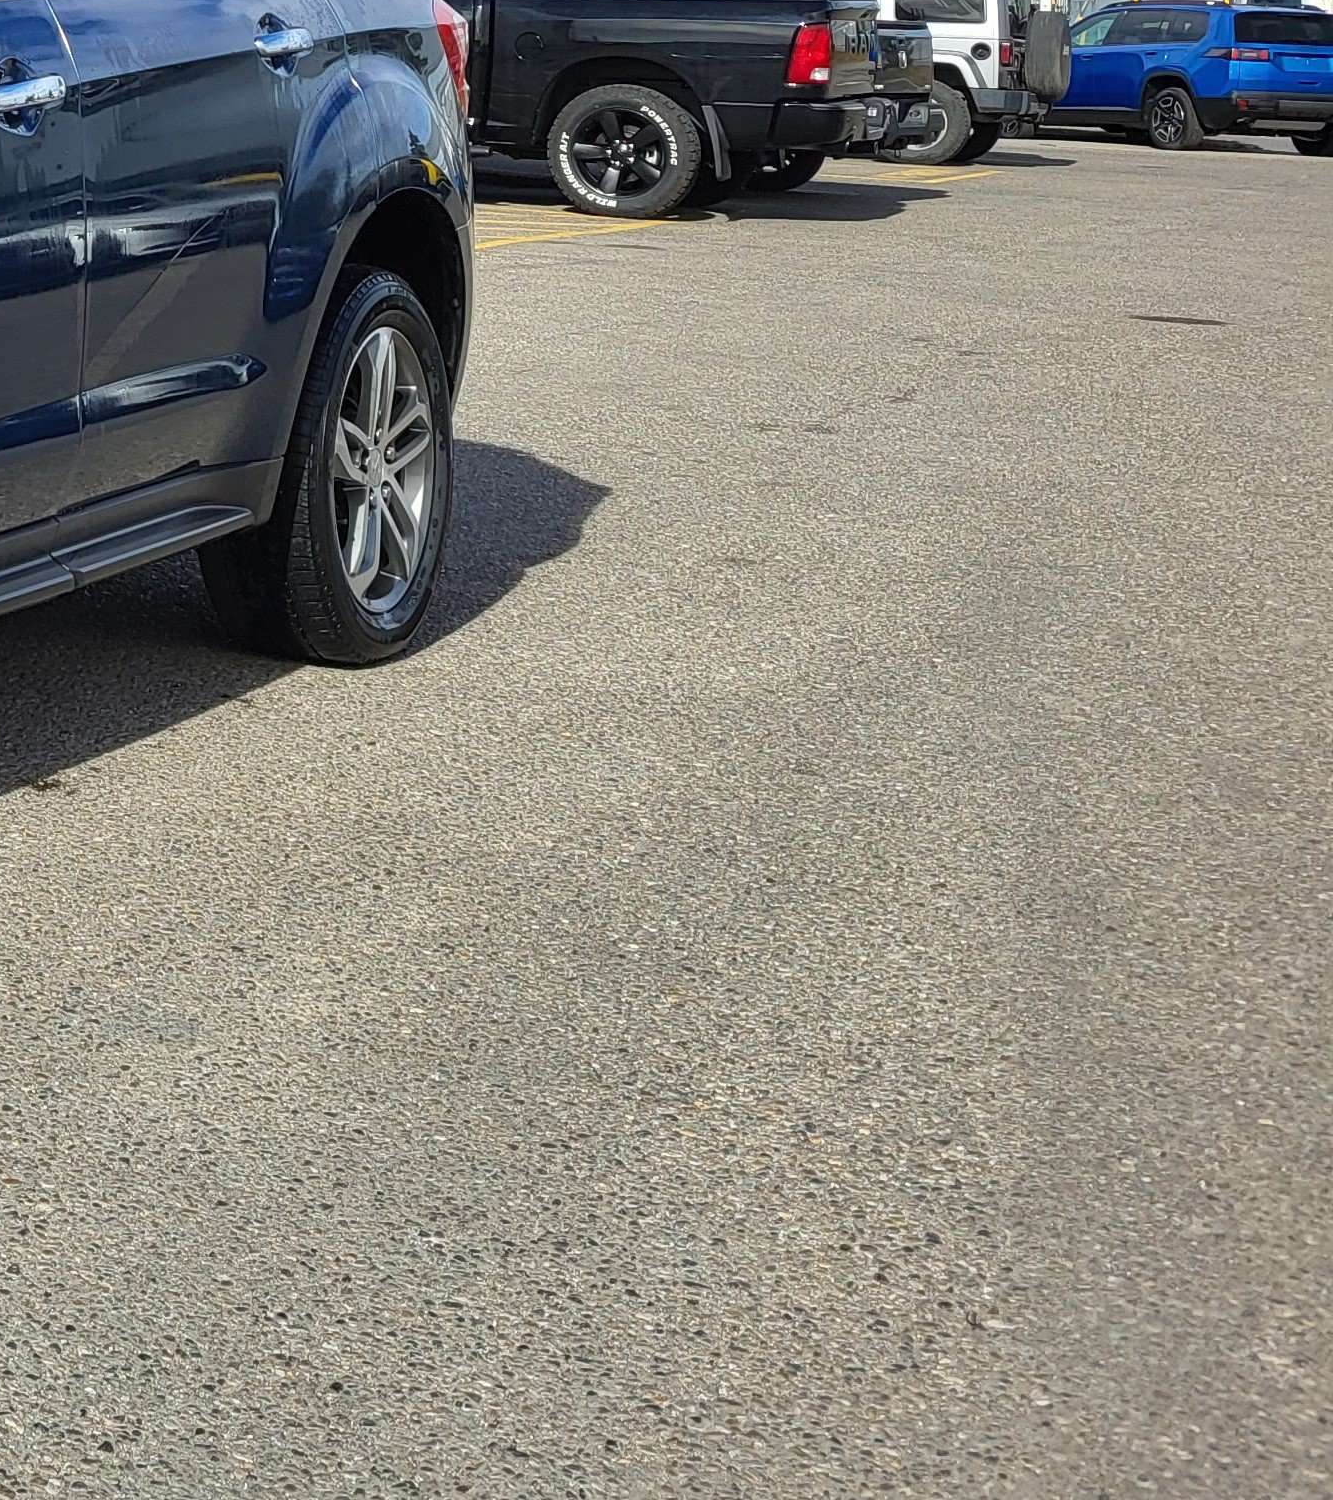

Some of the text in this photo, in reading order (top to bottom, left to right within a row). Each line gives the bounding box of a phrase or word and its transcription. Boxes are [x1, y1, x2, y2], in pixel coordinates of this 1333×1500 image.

[641, 105, 678, 166] POWERTRAC
[559, 153, 588, 195] RANGER
[586, 193, 618, 208] WILD
